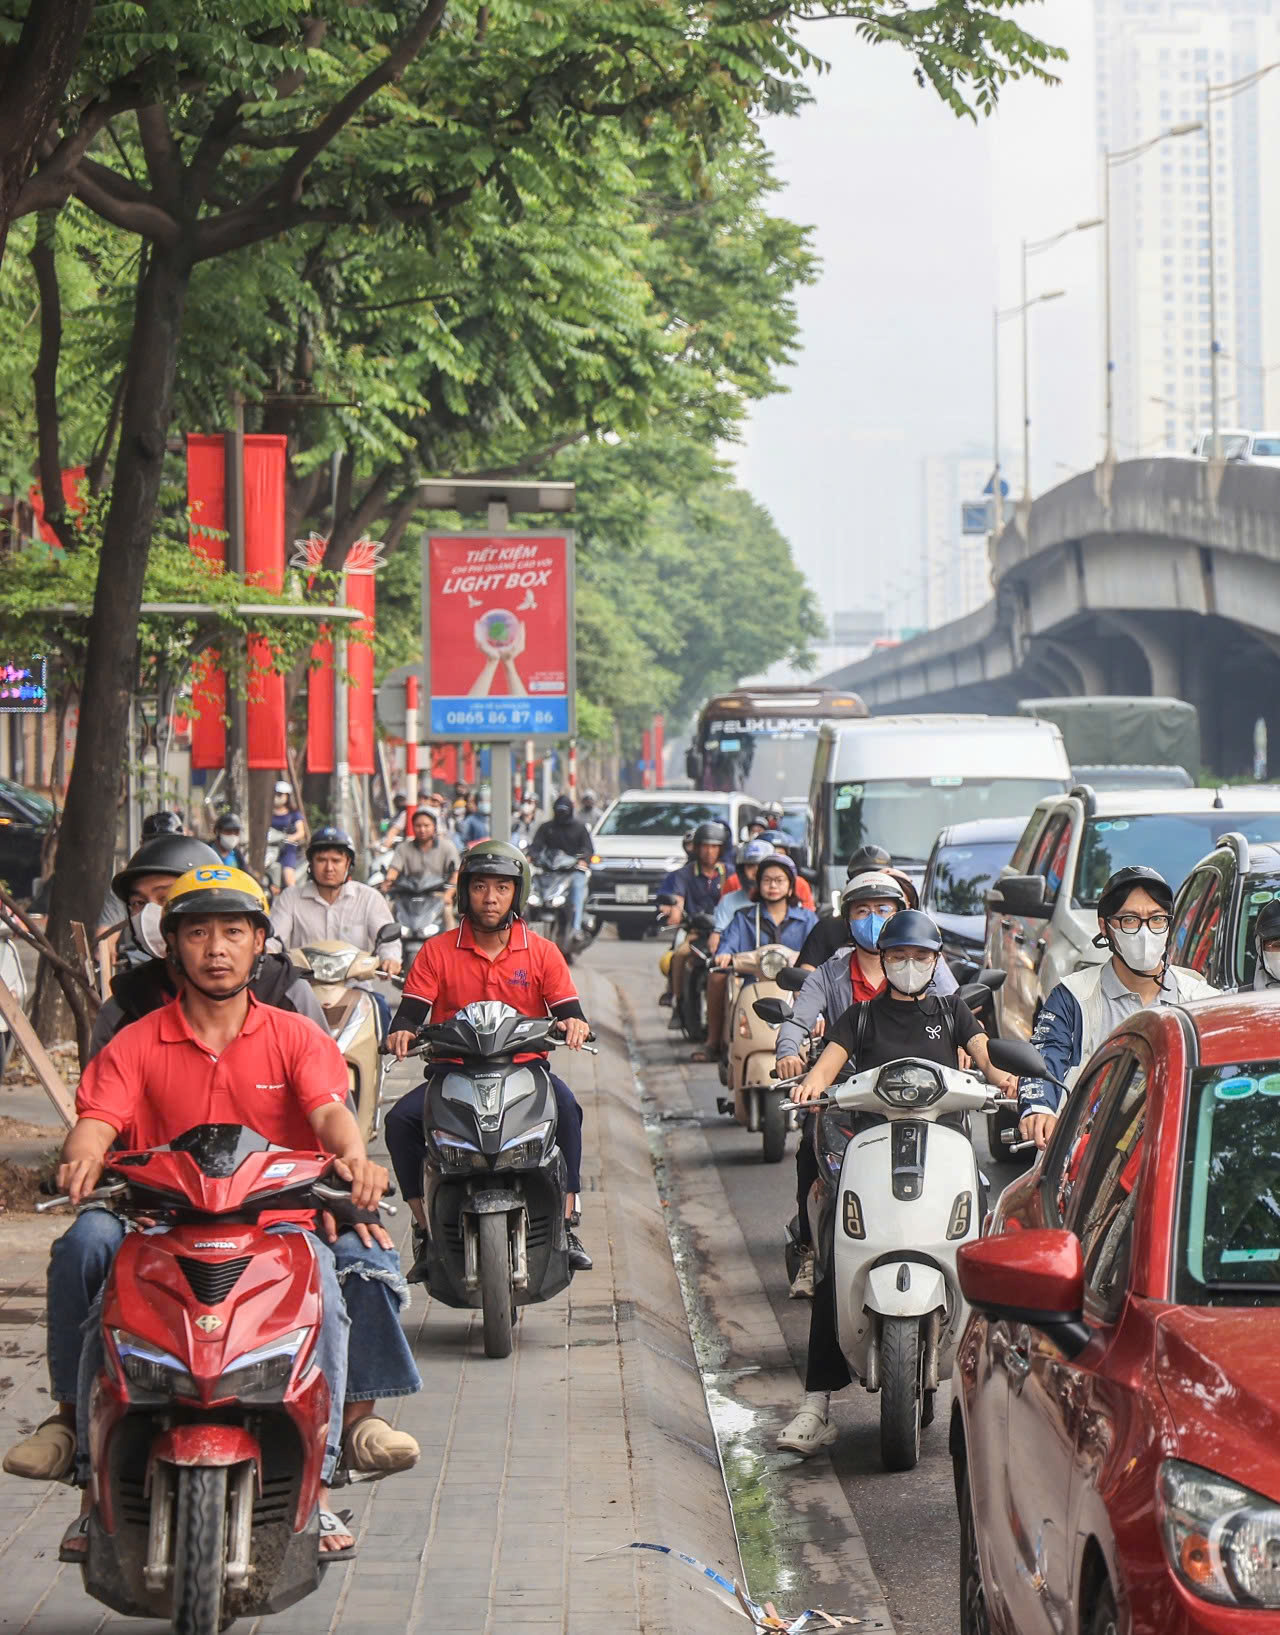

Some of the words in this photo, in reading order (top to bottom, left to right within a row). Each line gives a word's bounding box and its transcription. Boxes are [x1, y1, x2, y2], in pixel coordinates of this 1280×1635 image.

[466, 546, 498, 563] TIẾT
[498, 544, 538, 560] KIỆM
[442, 574, 505, 594] LIGHT
[505, 569, 552, 589] BOX
[446, 711, 485, 724] 0865
[488, 711, 507, 724] 86
[511, 711, 530, 724] 87
[535, 711, 553, 724] 86
[710, 718, 765, 734] FELIX
[765, 718, 829, 732] LIMOU
[196, 869, 232, 881] be
[194, 1241, 238, 1249] HONDA
